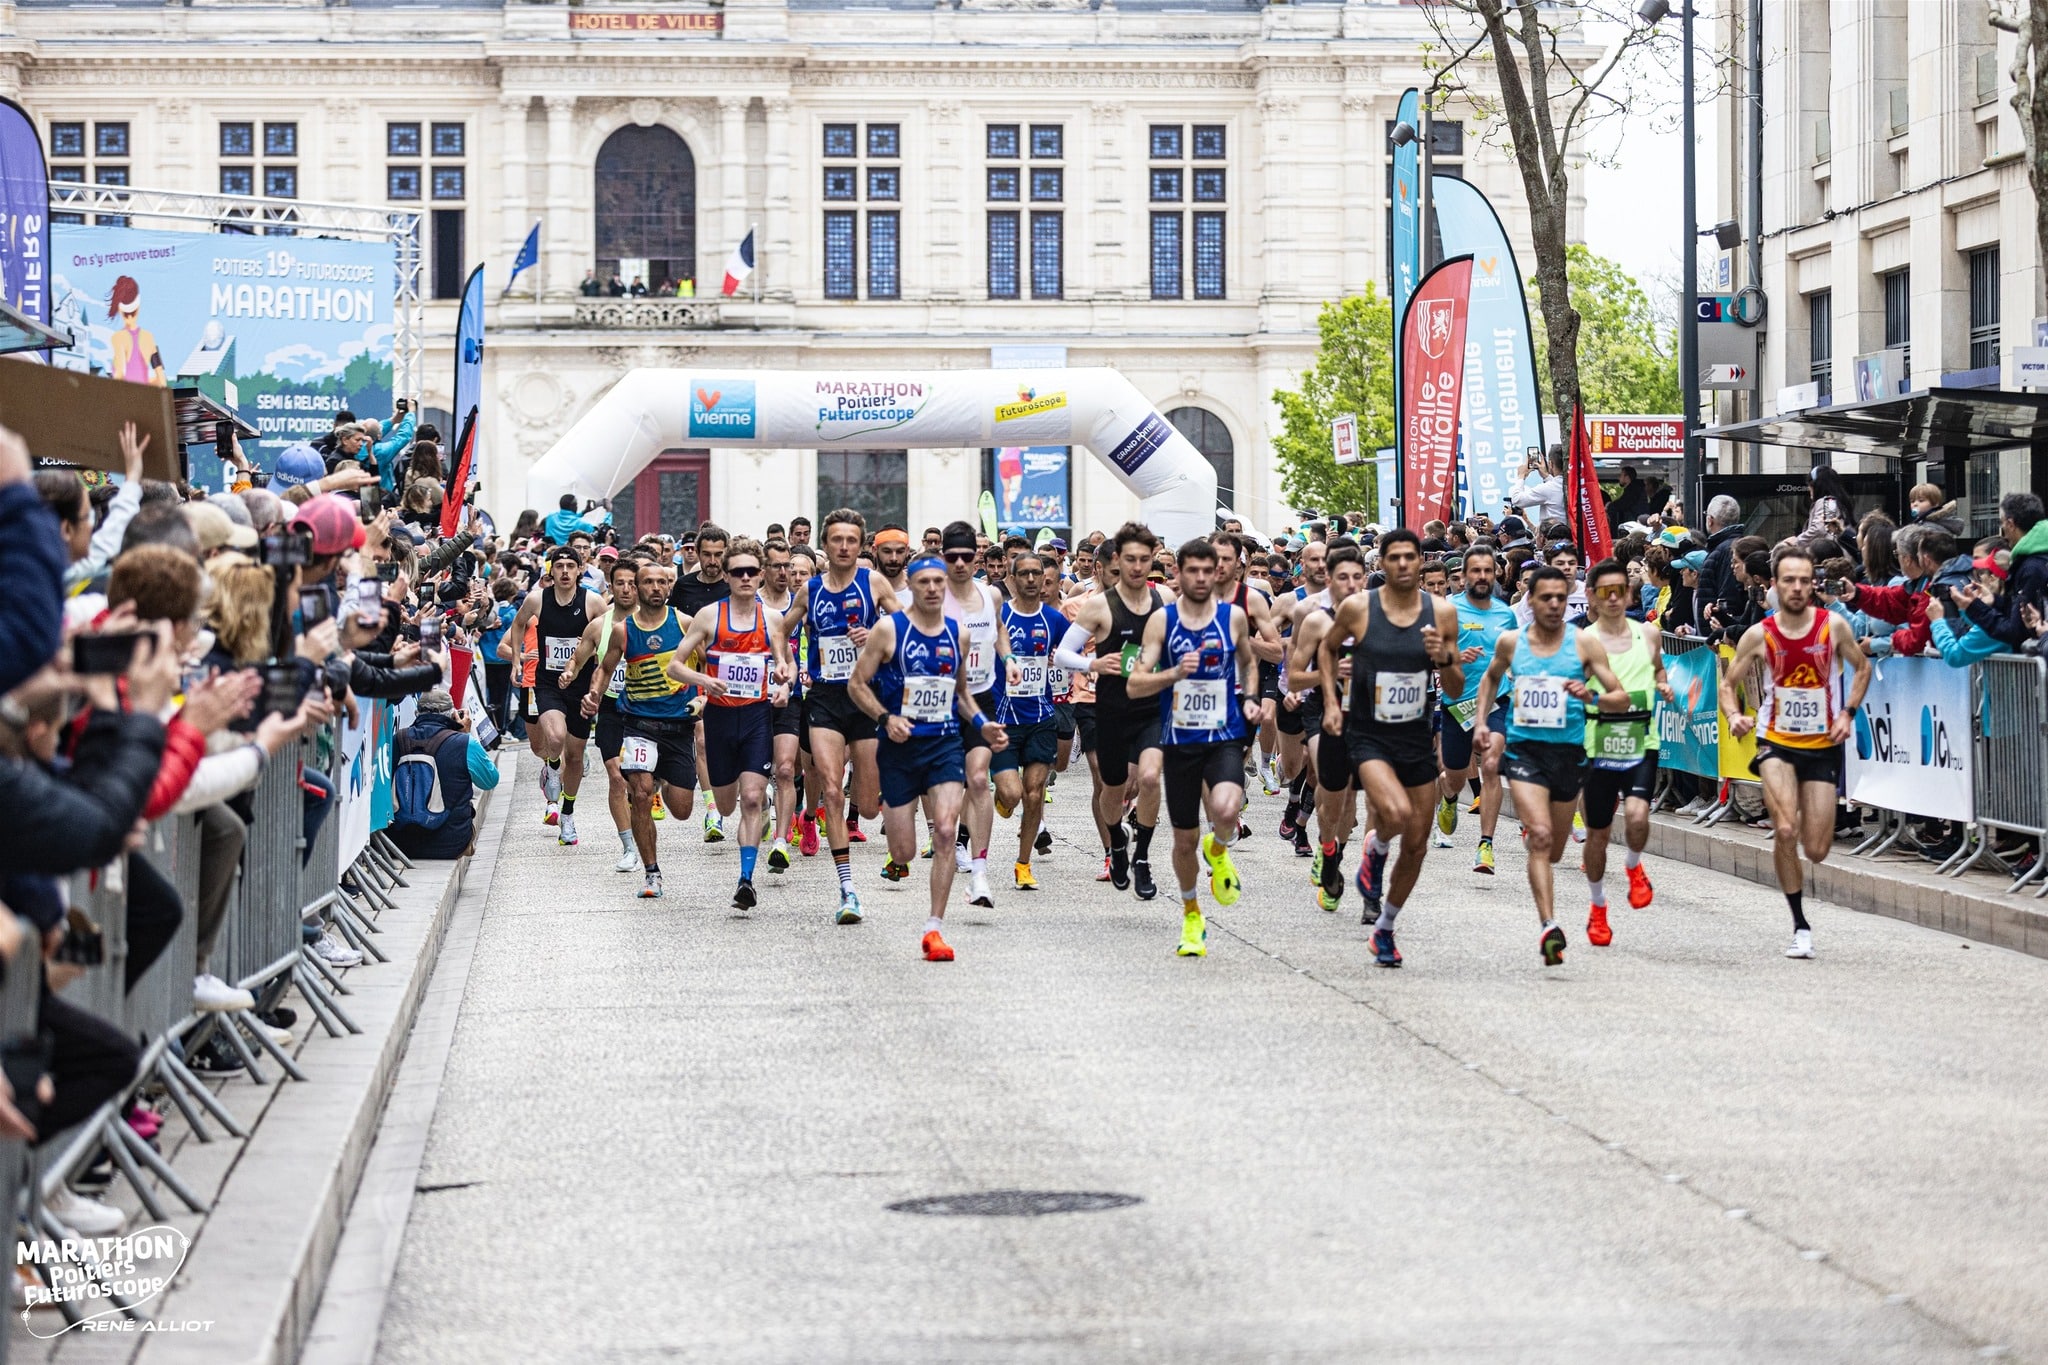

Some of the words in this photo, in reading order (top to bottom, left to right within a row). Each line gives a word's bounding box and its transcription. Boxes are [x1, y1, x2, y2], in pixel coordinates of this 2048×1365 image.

[575, 15, 632, 29] HOTEL
[636, 15, 660, 29] DE
[665, 15, 717, 29] VILLE
[73, 255, 88, 267] On
[89, 253, 104, 267] s'y
[105, 250, 147, 264] retrouve
[212, 258, 264, 277] POITIERS
[298, 262, 375, 283] FUTUROSCOPE
[210, 282, 375, 323] MARATHON
[2021, 363, 2045, 371] VICTOR
[816, 381, 922, 397] MARATHON
[256, 394, 283, 409] SEMI
[294, 395, 331, 410] RELAIS
[838, 395, 896, 409] Poitiers
[1000, 395, 1062, 418] futuroscope
[694, 413, 751, 425] vienne
[819, 408, 914, 422] Futuroscope
[256, 417, 287, 432] TOUT
[1603, 423, 1615, 436] la
[1618, 423, 1677, 436] Nouvelle
[1408, 415, 1418, 470] RÉGION
[1618, 435, 1684, 452] Républiqu
[1776, 484, 1811, 493] JCDeca
[966, 621, 990, 629] OMON
[829, 647, 858, 665] 2051
[969, 653, 979, 668] 11
[612, 669, 625, 683] 20
[728, 665, 758, 683] 5035
[1022, 667, 1042, 682] 059
[913, 690, 947, 707] 2054
[1184, 693, 1217, 711] 2061
[1388, 686, 1420, 705] 2001
[1522, 690, 1559, 708] 2003
[1784, 701, 1818, 718] 2053
[1866, 702, 1894, 764] ici
[1603, 736, 1637, 754] 6059
[634, 748, 647, 763] 15
